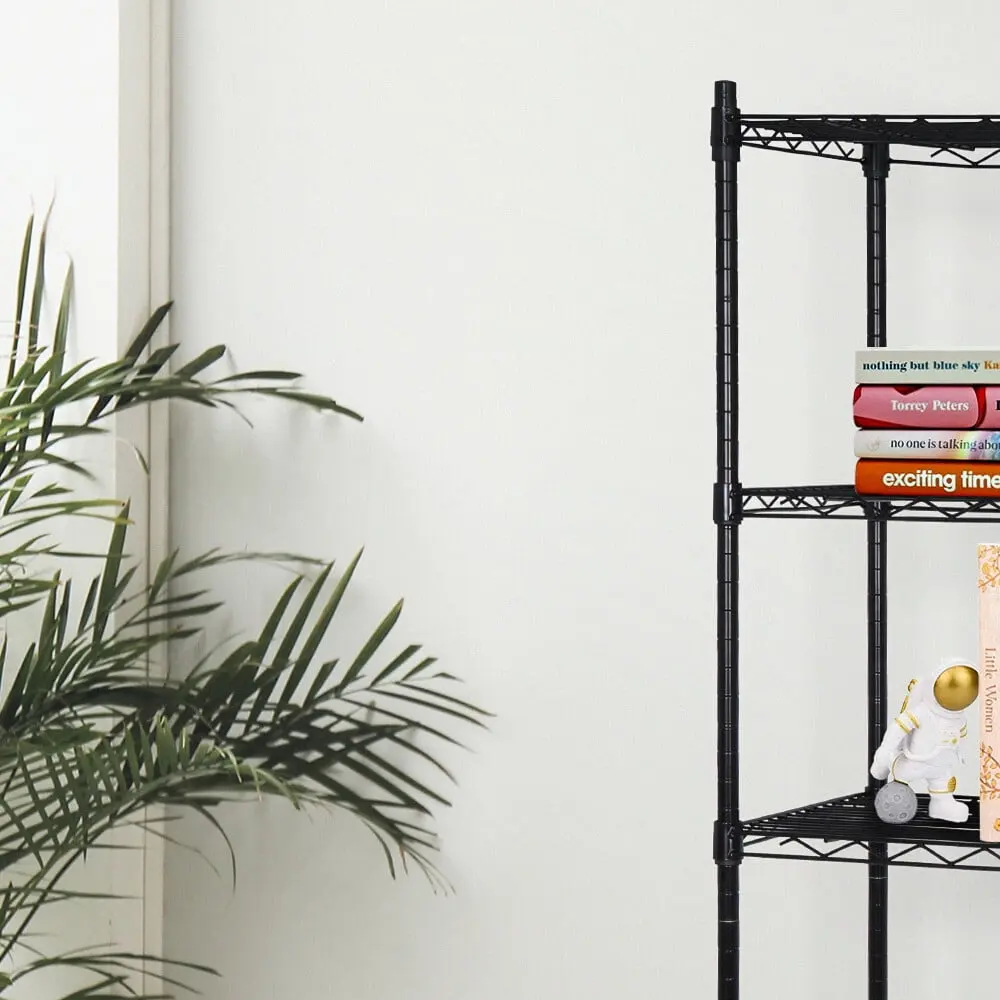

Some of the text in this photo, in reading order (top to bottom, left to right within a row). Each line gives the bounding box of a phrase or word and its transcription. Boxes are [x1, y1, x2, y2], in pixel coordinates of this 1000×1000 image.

[862, 360, 907, 373] nothing
[910, 360, 929, 370] but
[933, 360, 959, 370] blue
[961, 360, 980, 373] sky
[890, 399, 970, 413] Torrey Peters
[890, 439, 904, 449] no
[906, 439, 926, 449] one
[928, 438, 937, 449] is
[938, 438, 977, 451] talking
[882, 469, 956, 492] exciting
[985, 648, 998, 733] Little Women
